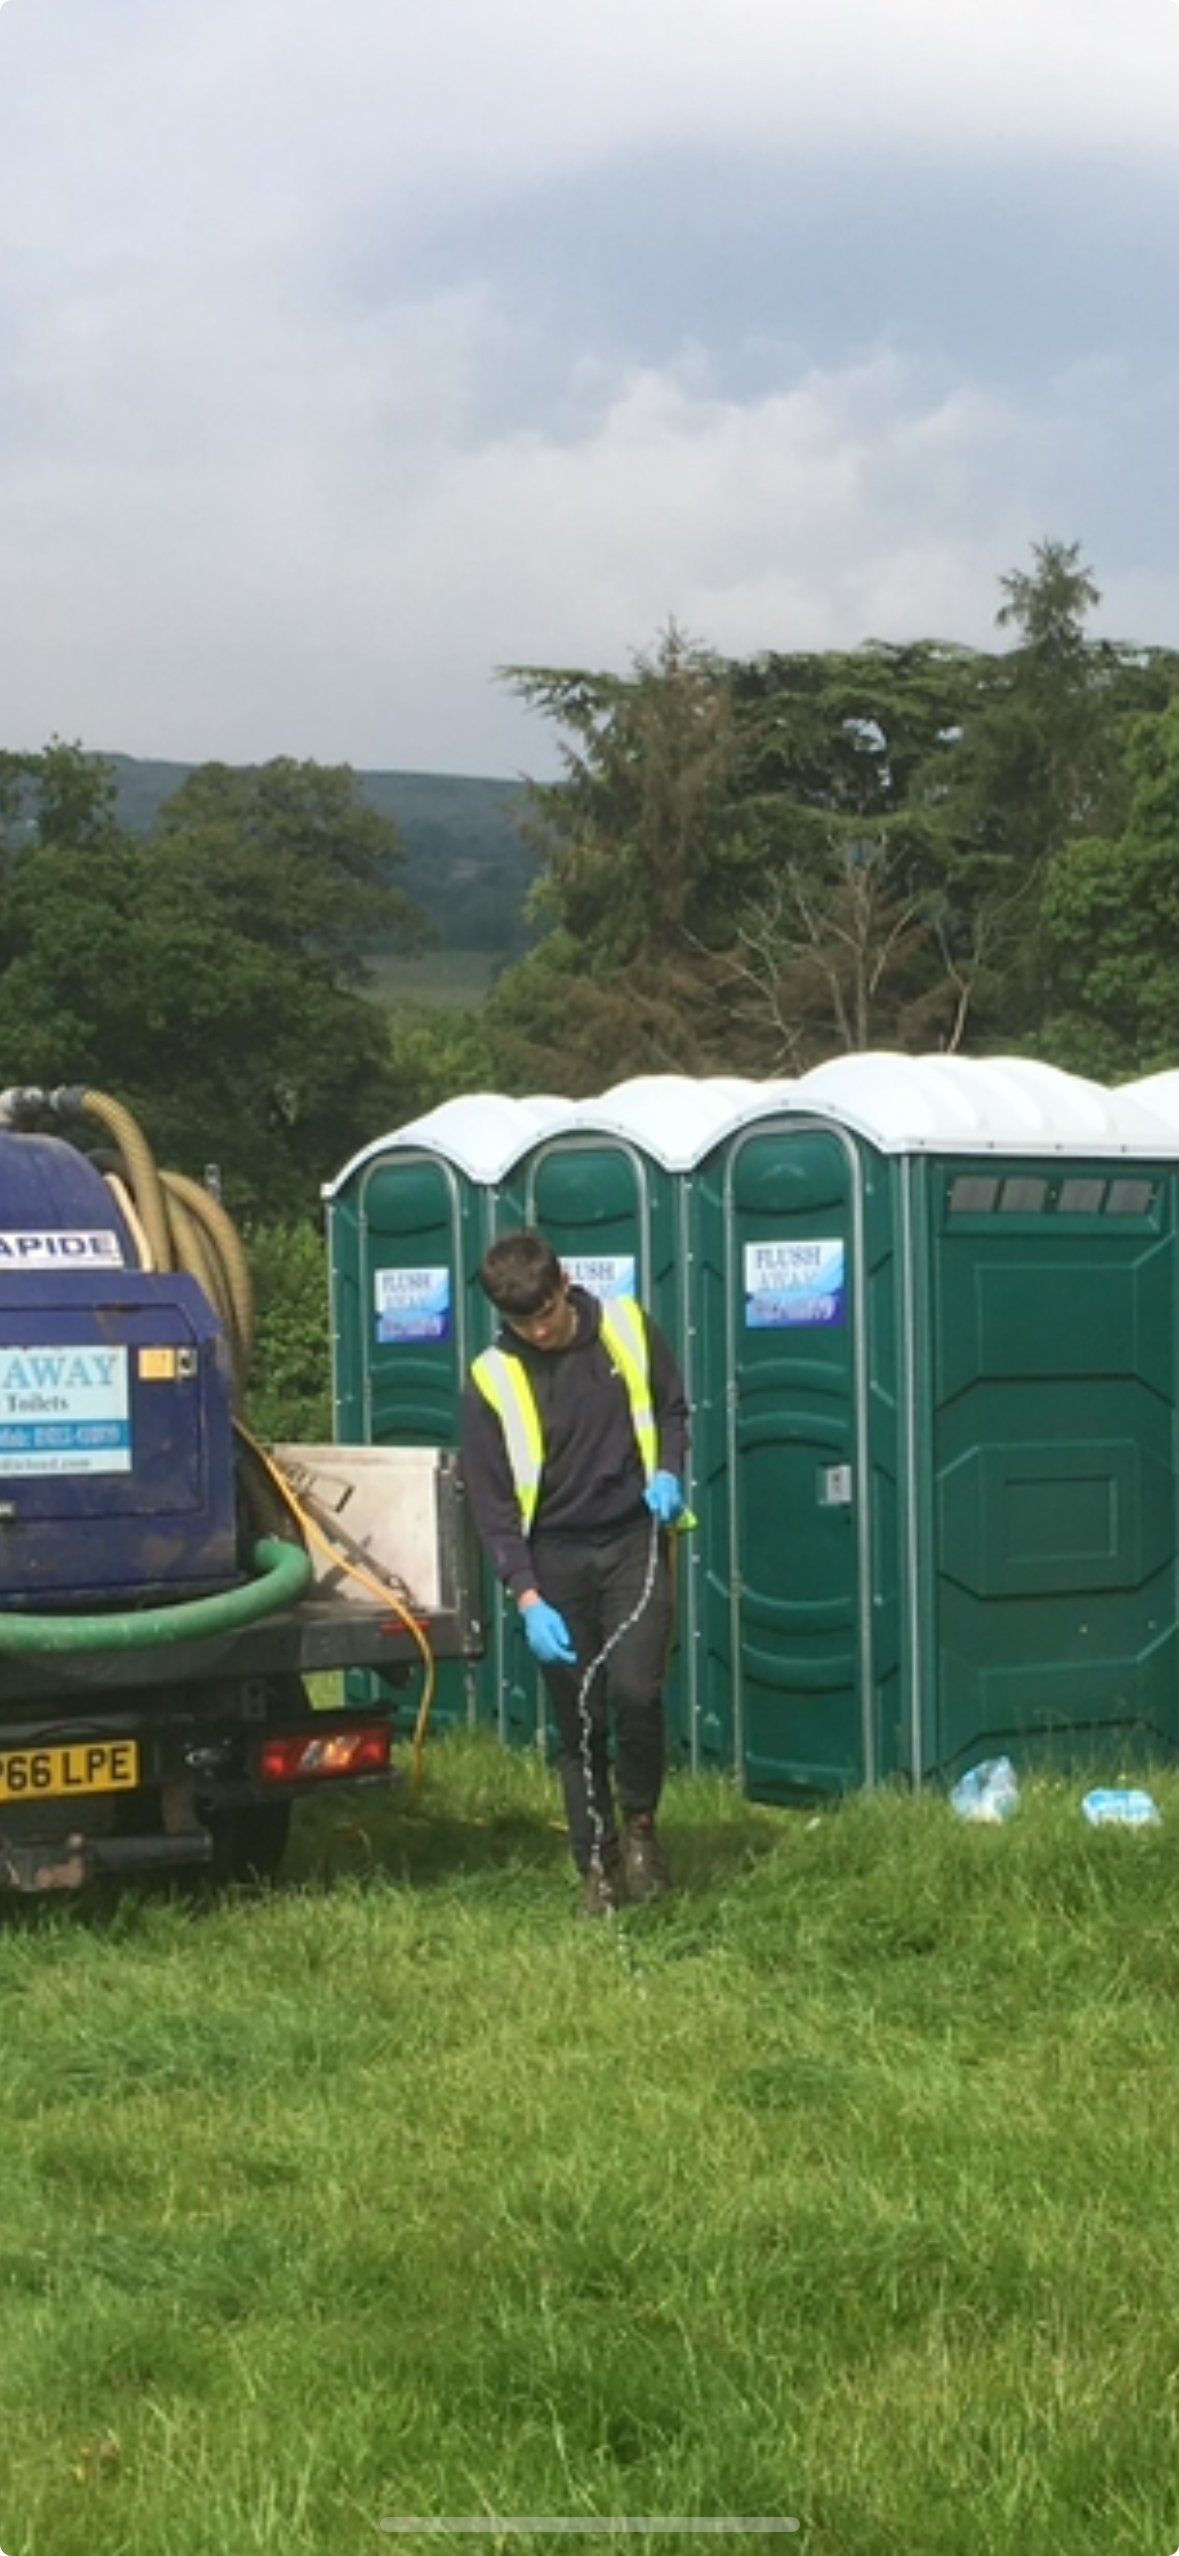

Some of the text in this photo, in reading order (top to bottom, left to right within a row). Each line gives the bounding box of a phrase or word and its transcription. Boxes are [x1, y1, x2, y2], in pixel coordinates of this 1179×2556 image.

[756, 1246, 820, 1269] FLUSH
[562, 1260, 616, 1281] LUSH
[2, 1353, 118, 1389] AWAY
[7, 1392, 69, 1412] Toilets
[61, 1746, 132, 1786] LPE
